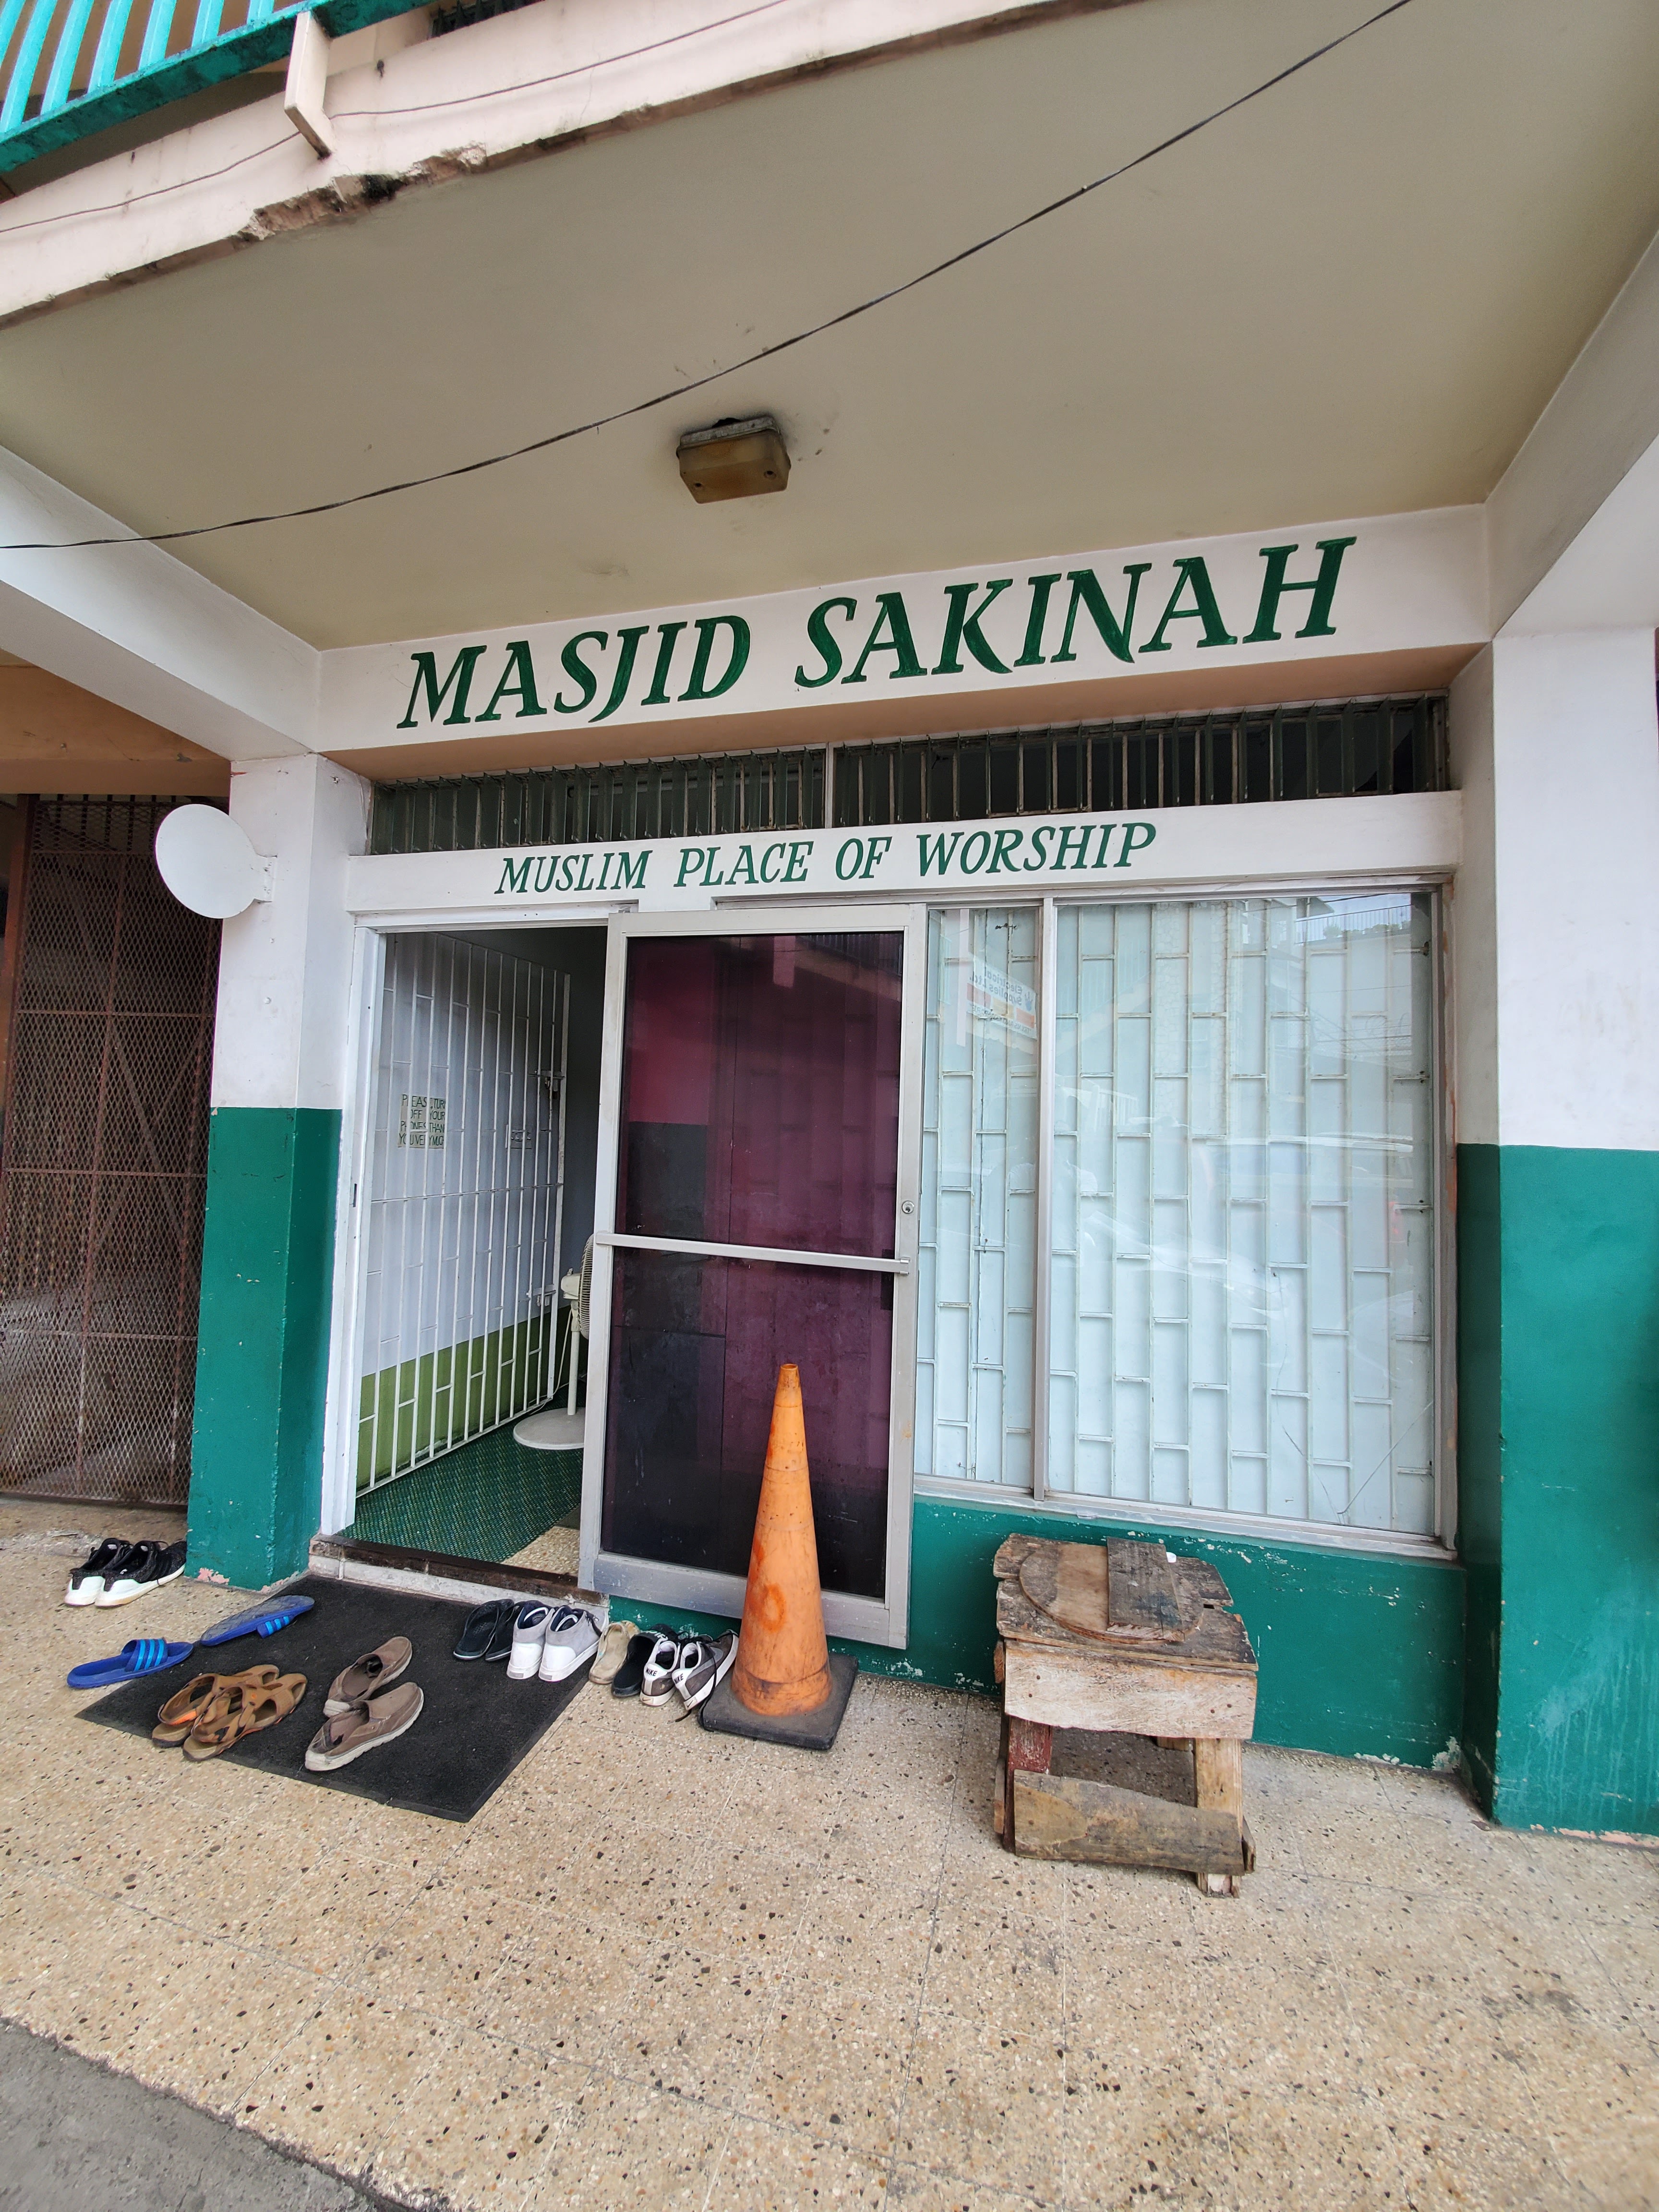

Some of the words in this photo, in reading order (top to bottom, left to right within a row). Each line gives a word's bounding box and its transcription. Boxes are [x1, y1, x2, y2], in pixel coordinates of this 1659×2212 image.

[397, 616, 750, 729] MASJID
[795, 537, 1357, 687] SAKINAH
[494, 850, 653, 894] MUSLIM
[673, 841, 813, 887] PLACE
[835, 837, 891, 880] OF
[916, 821, 1156, 877] WORSHIP
[646, 1667, 658, 1677] NIKE
[673, 1673, 684, 1684] NIKE
